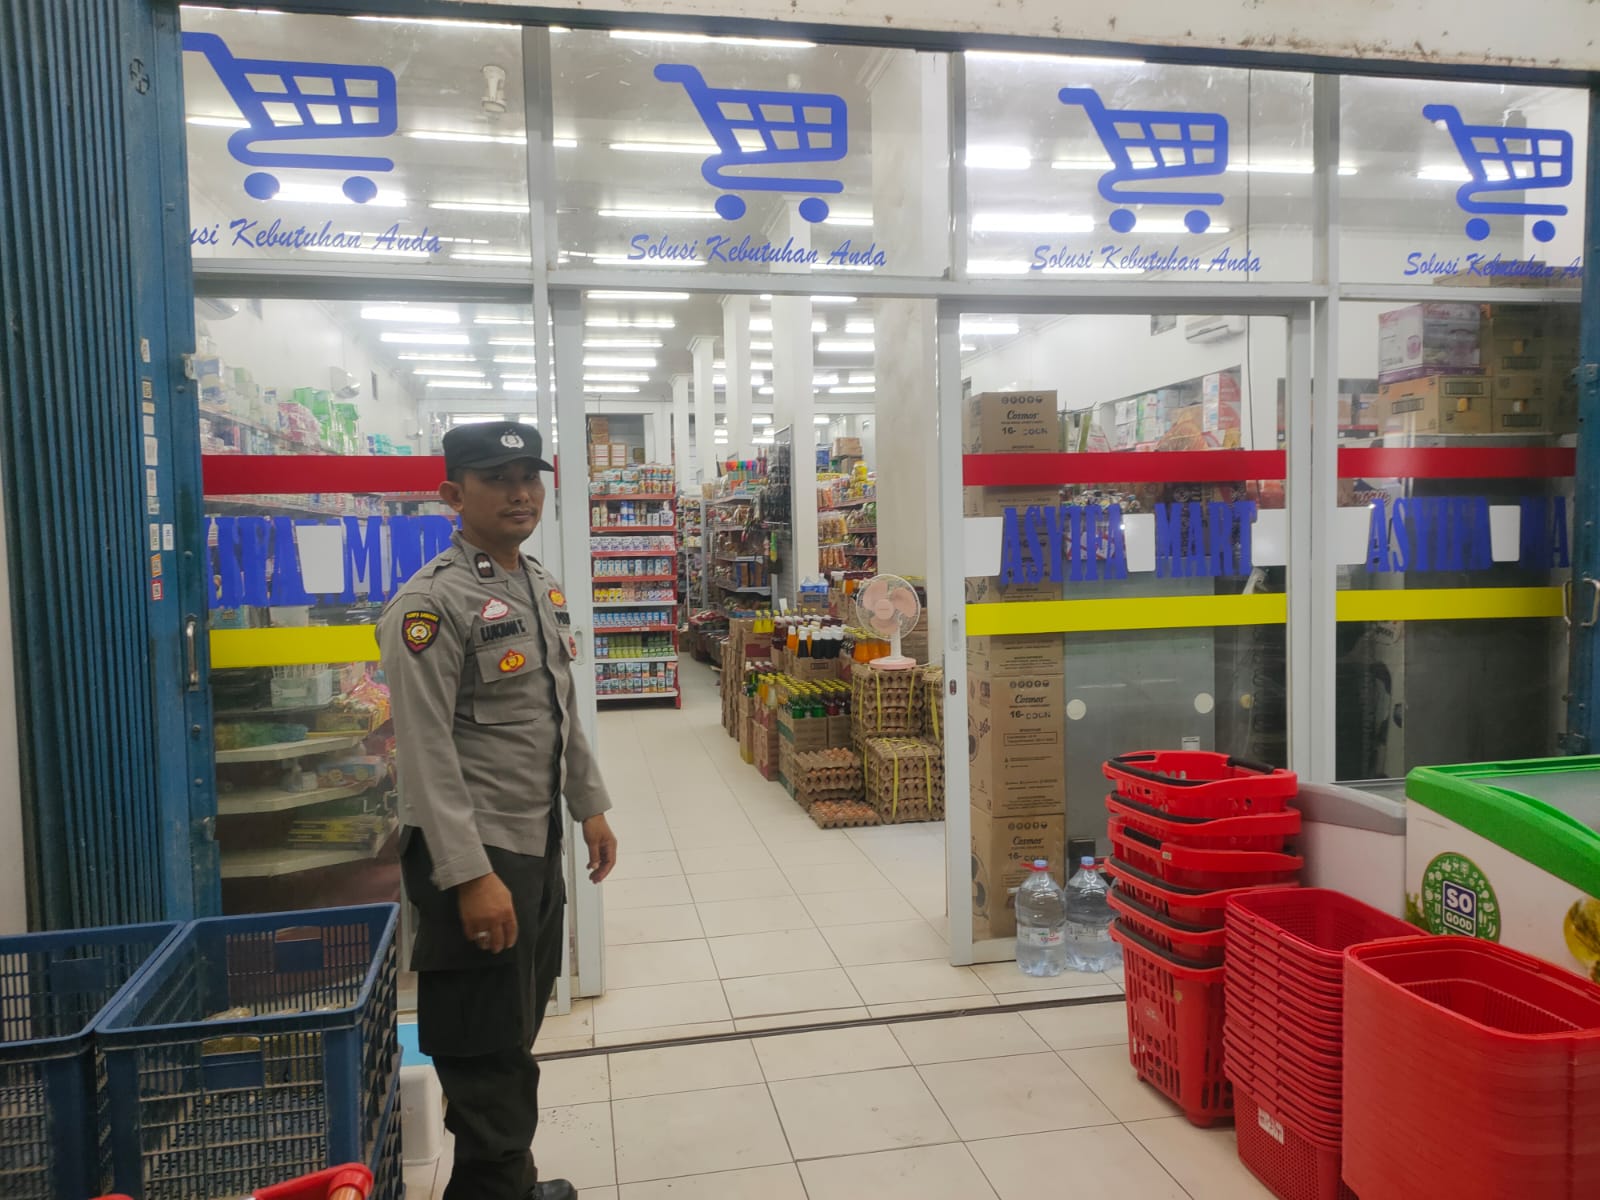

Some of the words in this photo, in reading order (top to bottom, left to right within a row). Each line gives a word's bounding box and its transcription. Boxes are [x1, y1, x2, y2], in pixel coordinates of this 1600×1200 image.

[229, 218, 362, 249] Kebutuhan
[368, 223, 442, 253] Anda
[627, 234, 698, 260] Solusi
[706, 234, 818, 264] Kebutuhan
[826, 239, 887, 267] Anda
[1030, 245, 1093, 270] Solusi
[1100, 245, 1200, 271] Kebutuhan
[1207, 247, 1262, 273] Anda
[1403, 252, 1460, 276] Solusi
[1466, 252, 1555, 279] Kebutuhan
[1002, 504, 1127, 584] ASYIFA
[1155, 501, 1257, 578] MART
[1367, 496, 1493, 573] ASYIFA
[1520, 496, 1571, 568] MA
[333, 515, 463, 604] MAR
[1446, 888, 1472, 914] SO
[1446, 912, 1472, 931] GOOD
